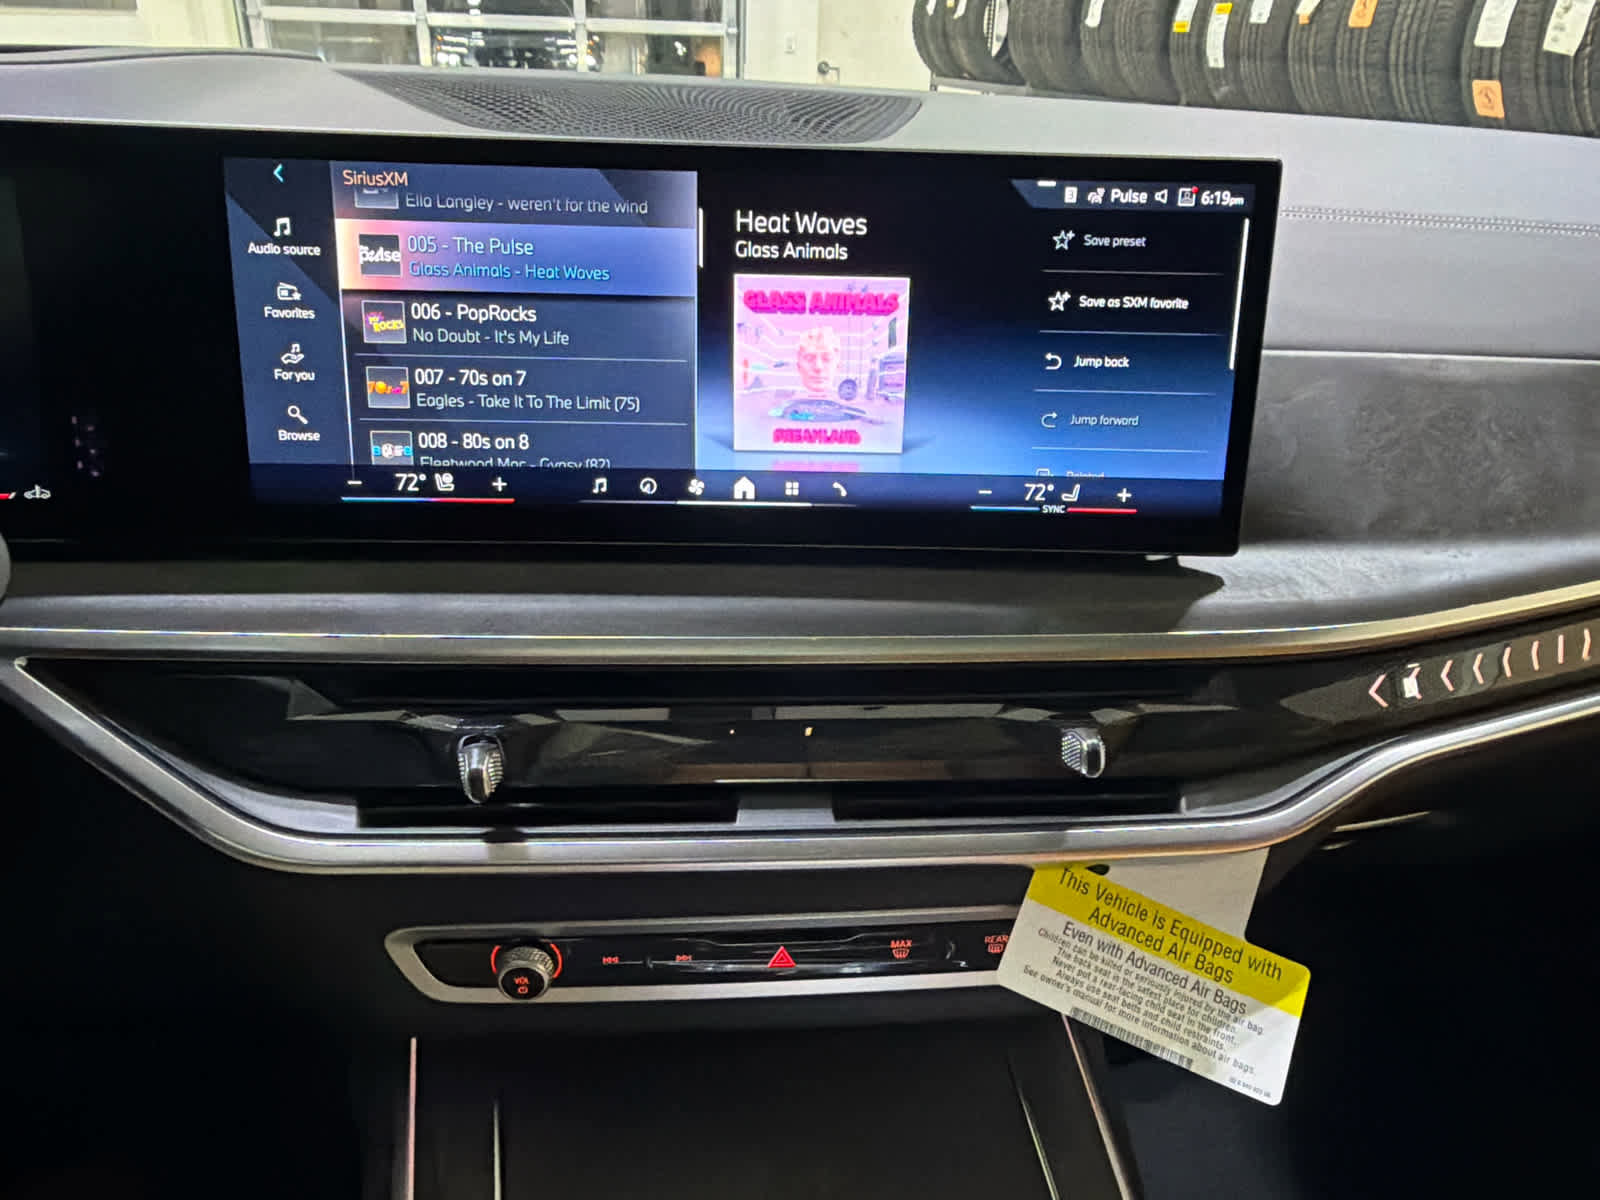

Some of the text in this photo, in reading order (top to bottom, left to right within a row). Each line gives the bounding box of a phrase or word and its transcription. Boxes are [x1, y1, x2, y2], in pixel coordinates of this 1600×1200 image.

[342, 170, 408, 187] SiriusXM
[405, 192, 432, 209] Ella
[436, 194, 494, 214] Langley
[507, 197, 563, 212] weren't
[565, 198, 585, 212] for
[588, 199, 610, 213] the
[614, 200, 649, 214] wind
[1110, 189, 1148, 204] Pulse
[1201, 191, 1245, 206] 6:19pm
[736, 209, 868, 236] Heat Waves
[248, 242, 321, 256] Audio source
[408, 236, 437, 253] 005
[452, 237, 484, 254] The
[489, 238, 534, 256] Pulse
[1083, 234, 1147, 248] Save preset
[735, 240, 848, 260] Glass Animals
[409, 261, 449, 277] Glass
[453, 263, 511, 279] Animals
[525, 264, 560, 280] Heat
[563, 266, 610, 281] Waves
[1079, 295, 1189, 310] Save as SXM favorite
[264, 306, 316, 319] Favorites
[411, 303, 441, 320] 006
[457, 305, 538, 324] PopRocks
[413, 328, 434, 343] No
[438, 329, 481, 344] Doubt
[494, 330, 516, 345] It's
[519, 331, 541, 347] My
[544, 331, 569, 345] Life
[1074, 356, 1130, 369] Jump back
[274, 369, 316, 382] For you
[415, 369, 443, 385] 007
[459, 369, 488, 386] 70s
[492, 373, 513, 386] on
[516, 370, 527, 386] 7
[416, 394, 465, 411] Eagles
[478, 394, 510, 409] Take
[514, 394, 526, 409] It
[526, 394, 543, 409] To
[546, 395, 572, 410] The
[577, 396, 611, 410] Limit
[615, 397, 640, 413] (75)
[1070, 415, 1139, 426] Jump forward
[278, 429, 320, 441] Browse
[418, 432, 447, 449] 008
[463, 433, 491, 449] 80s
[494, 437, 515, 449] on
[519, 434, 530, 450] 8
[1042, 505, 1066, 514] SYNC
[1059, 867, 1091, 895] This
[1095, 882, 1148, 921] Vehicle
[1169, 917, 1244, 964] Equipped
[1247, 955, 1282, 981] with
[890, 940, 912, 949] MAX
[1087, 906, 1234, 984] Advanced Air Bags
[1062, 920, 1247, 1015] Even with Advanced Air Bags
